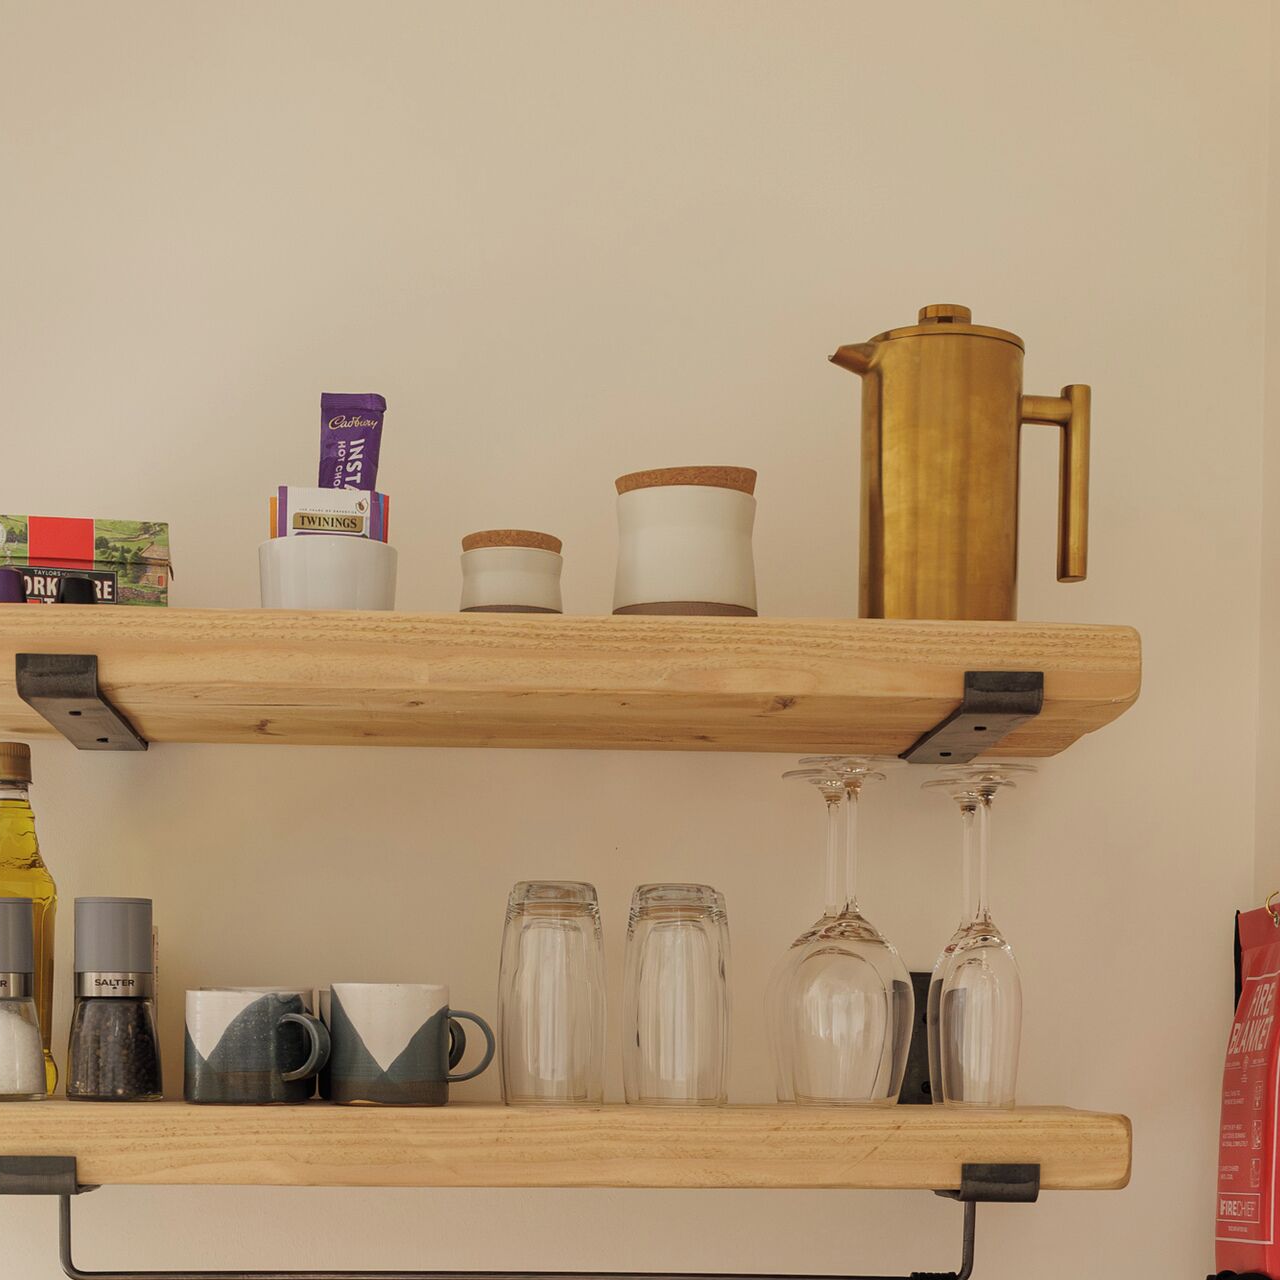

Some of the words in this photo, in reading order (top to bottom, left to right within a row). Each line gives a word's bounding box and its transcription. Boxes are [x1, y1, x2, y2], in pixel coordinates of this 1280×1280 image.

[328, 414, 378, 430] Cadbury
[337, 440, 346, 462] HOT
[299, 515, 357, 529] TWININGS
[33, 569, 61, 577] TAYLORS
[94, 978, 135, 987] SALTER
[1247, 982, 1276, 1018] FIRE
[1228, 1015, 1274, 1055] BLANKET
